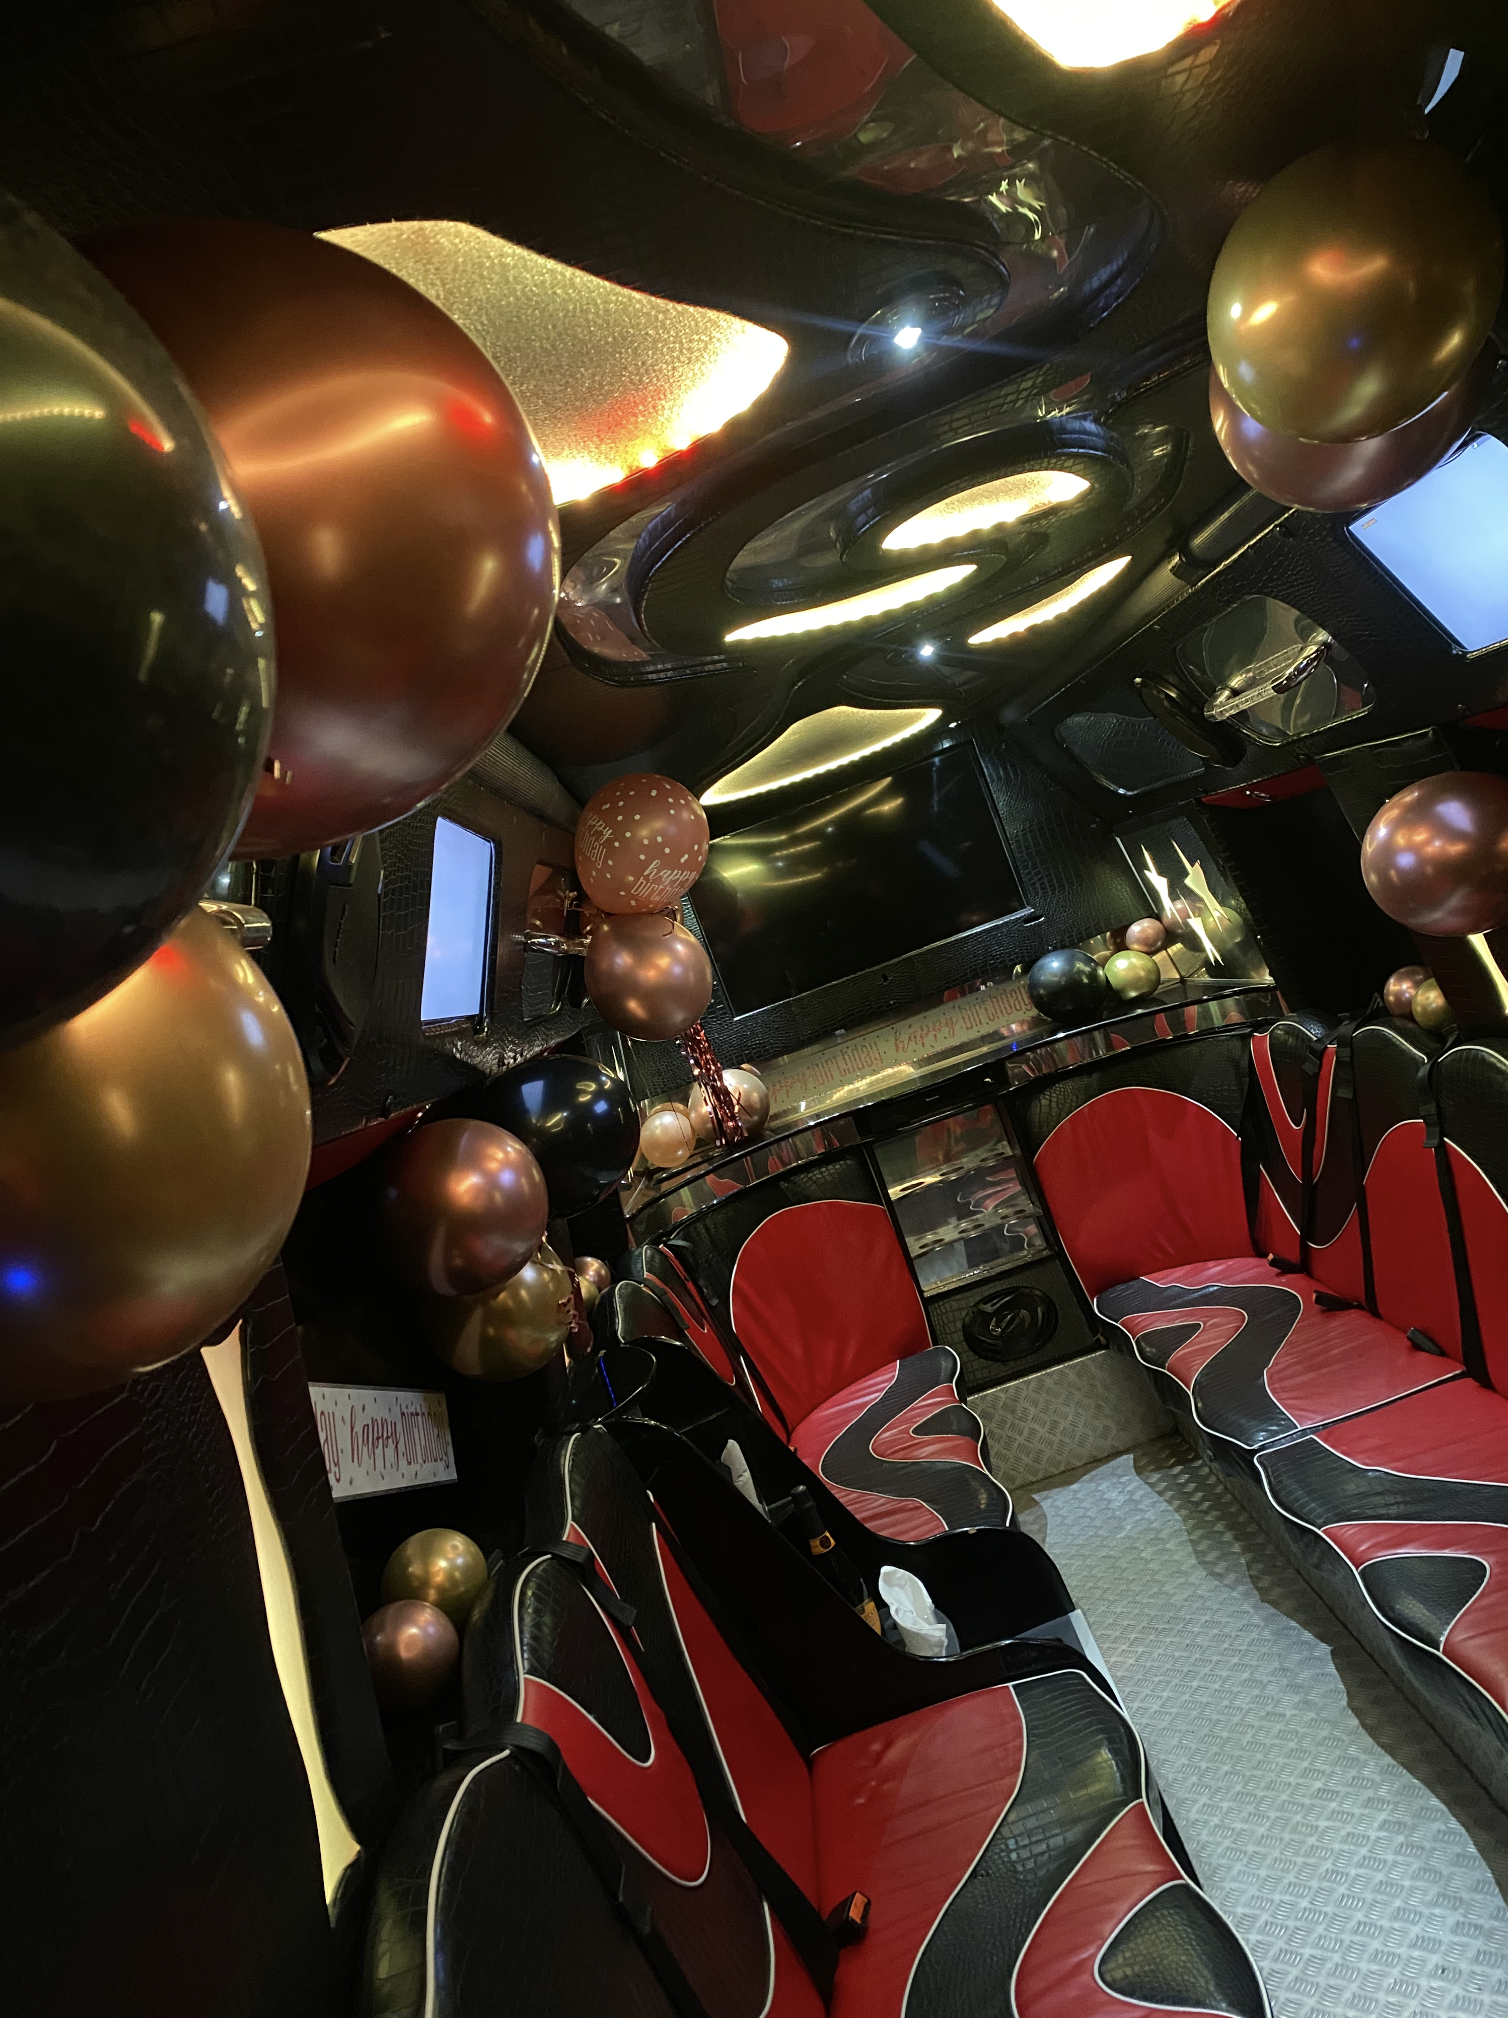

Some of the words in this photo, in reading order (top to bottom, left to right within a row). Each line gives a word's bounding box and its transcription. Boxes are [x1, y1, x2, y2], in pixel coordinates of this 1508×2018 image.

[585, 811, 614, 843] appy
[643, 859, 699, 887] happy
[811, 1038, 884, 1086] birthday
[894, 1014, 959, 1053] happy
[959, 984, 1033, 1030] birthday
[313, 1401, 342, 1484] ay
[350, 1404, 400, 1472] happy
[400, 1403, 449, 1470] birthday
